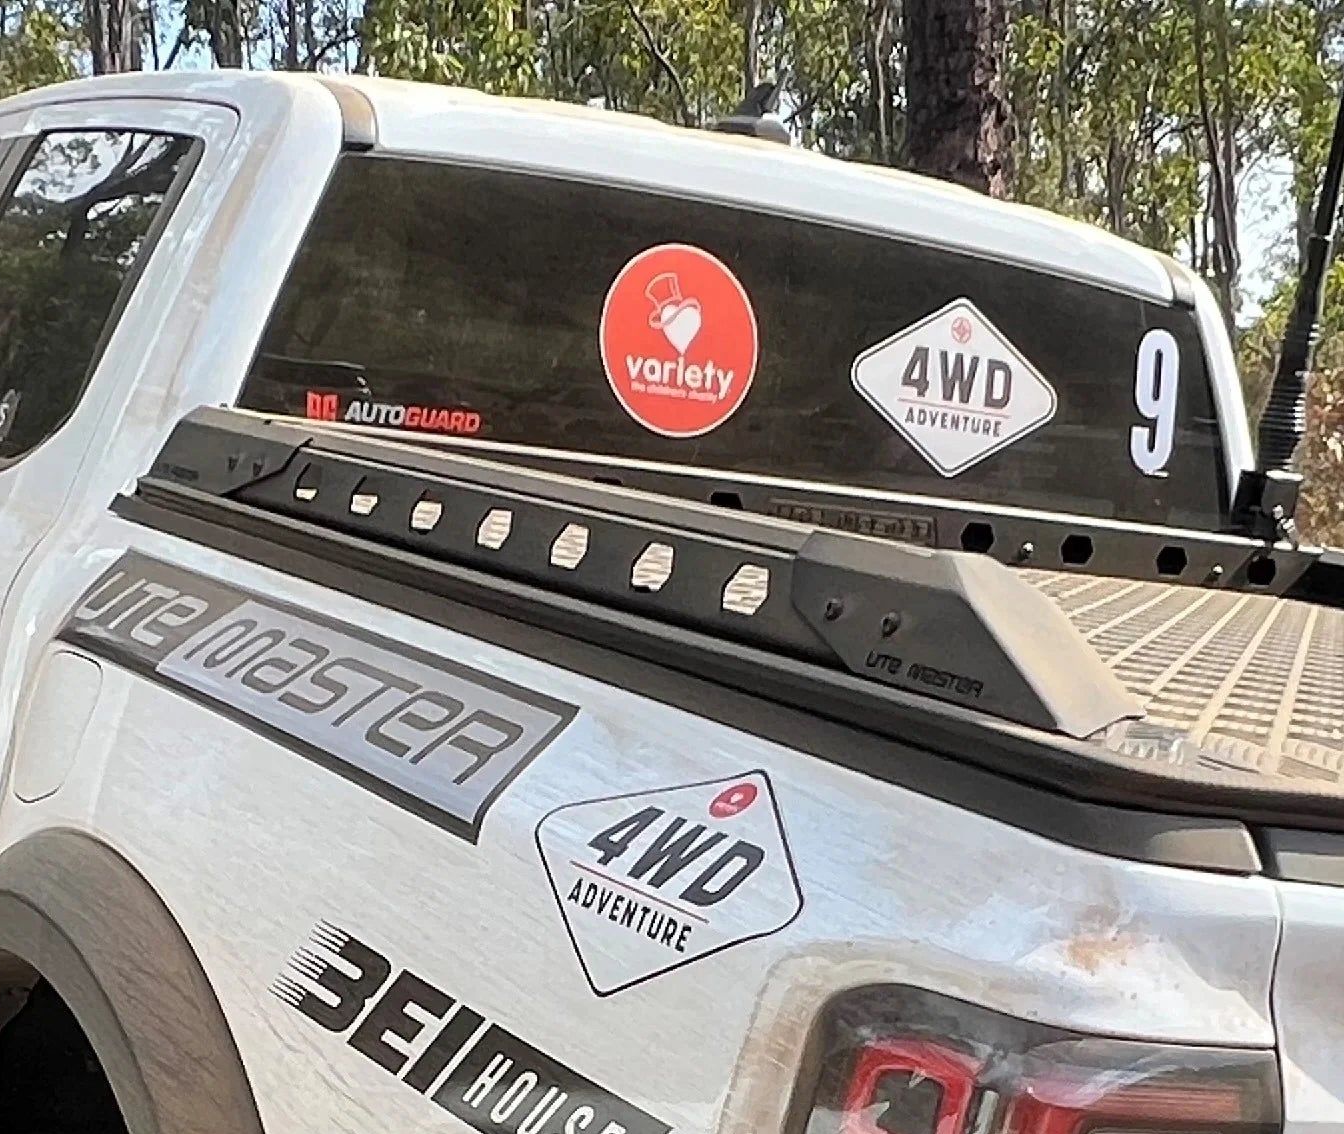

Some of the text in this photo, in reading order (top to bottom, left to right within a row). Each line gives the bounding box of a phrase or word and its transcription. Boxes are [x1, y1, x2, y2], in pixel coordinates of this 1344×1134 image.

[625, 354, 734, 401] variety
[900, 346, 1013, 410] 4WD
[1130, 328, 1180, 476] 9
[344, 400, 481, 433] AUTOGUARD
[904, 406, 1003, 438] ADVENTURE
[587, 805, 766, 907] 4WD
[566, 877, 693, 953] ADVENTURE
